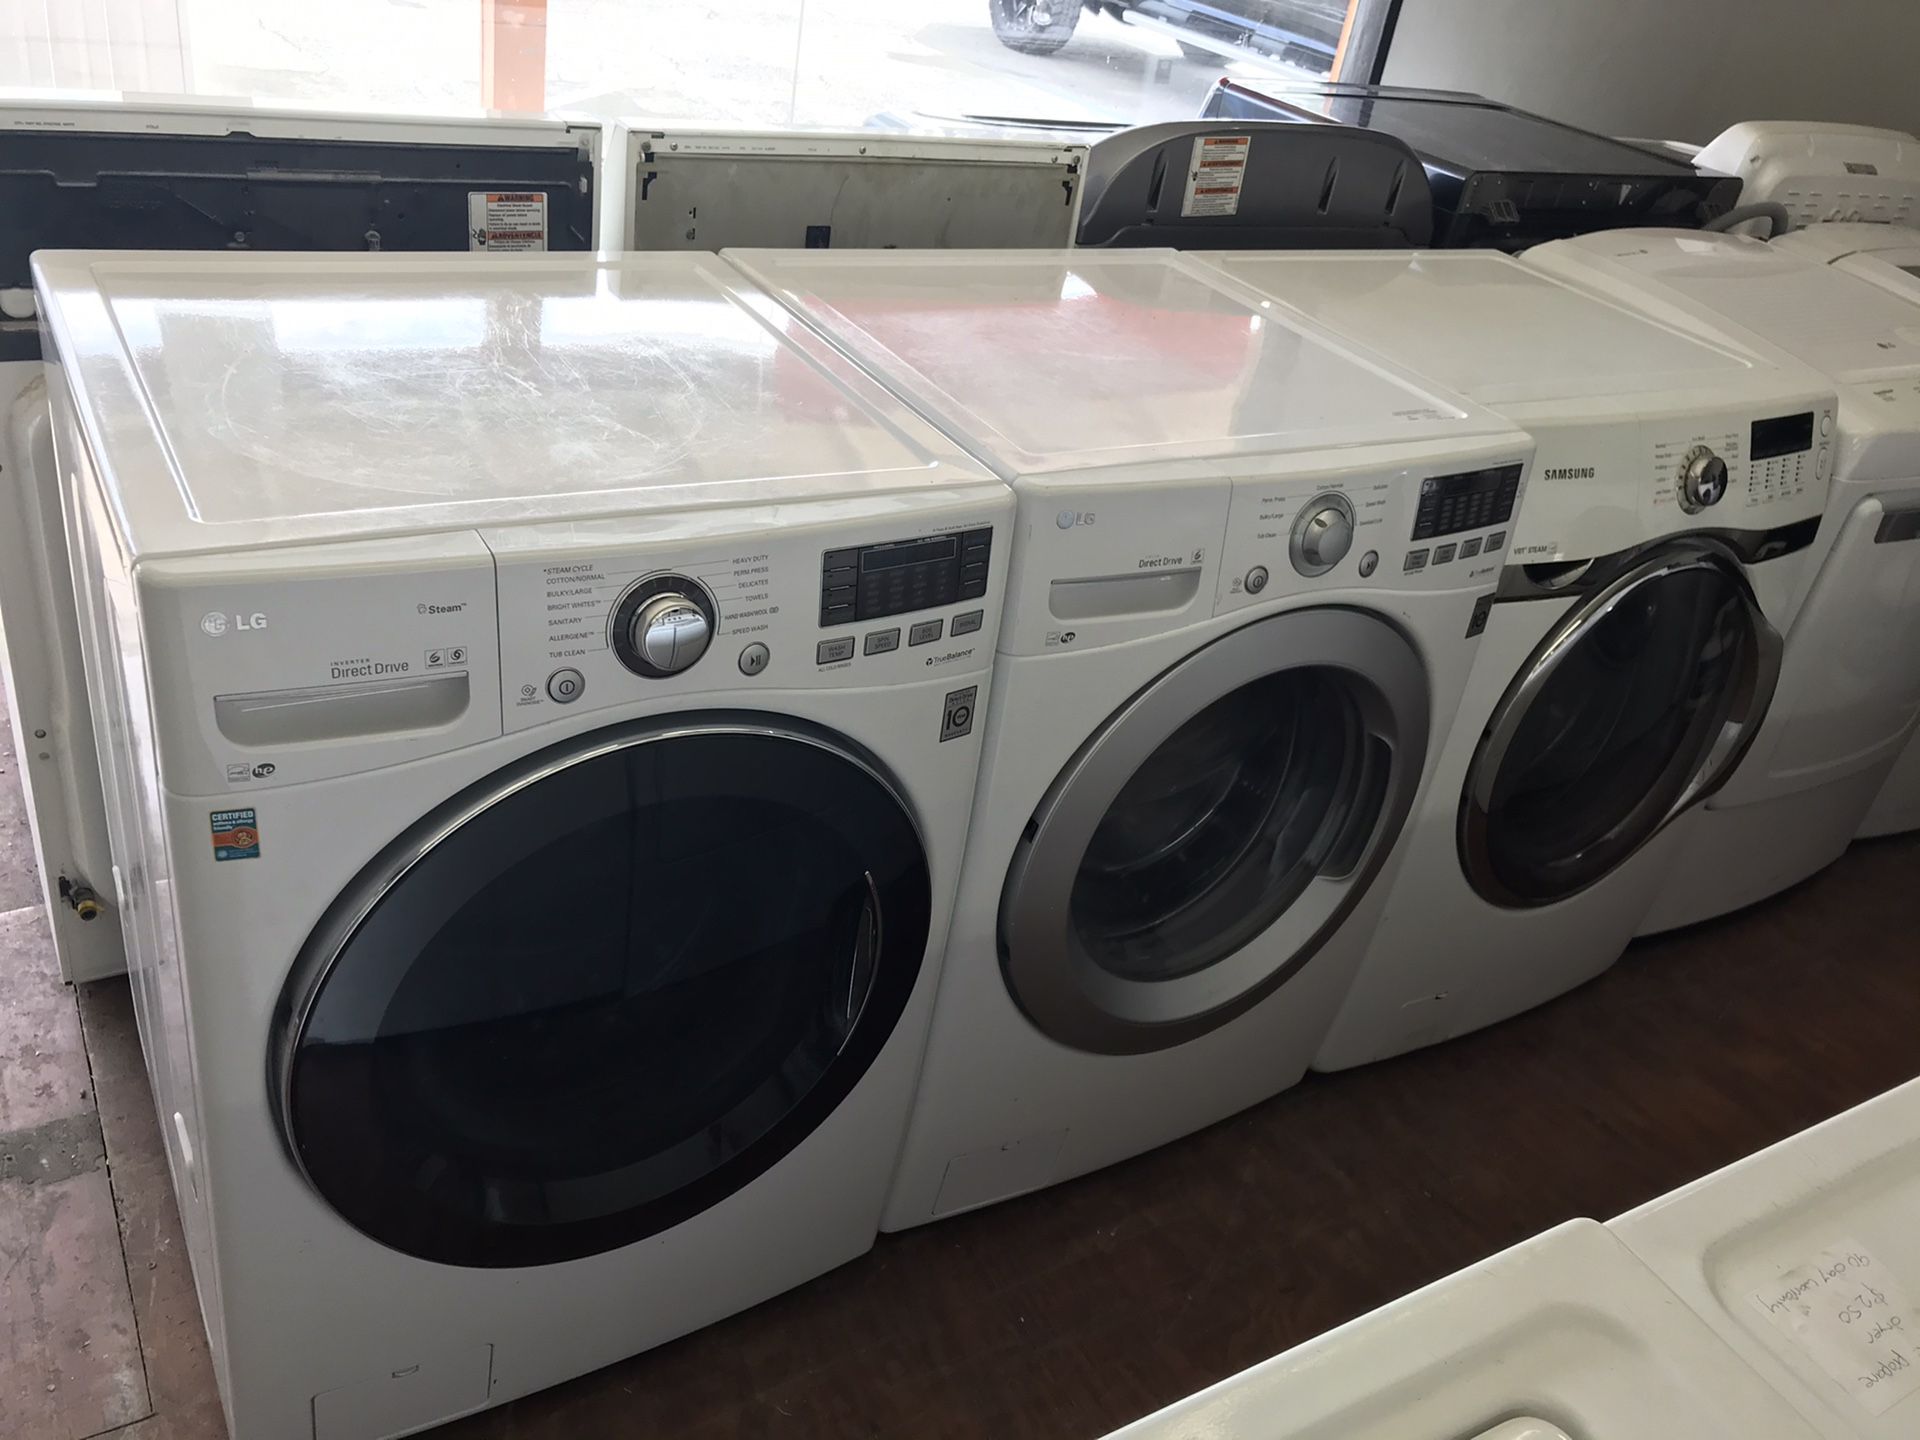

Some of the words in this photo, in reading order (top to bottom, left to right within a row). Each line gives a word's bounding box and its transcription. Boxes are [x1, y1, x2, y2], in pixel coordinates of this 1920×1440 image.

[1544, 467, 1595, 481] SAMSUNG
[1075, 512, 1096, 525] LG
[732, 556, 752, 564] HEAVY
[752, 554, 769, 562] DUTY
[1138, 556, 1162, 569] Direct
[1163, 556, 1183, 567] Drive
[572, 564, 593, 573] CYCLE
[546, 573, 605, 585] COTTON/NORMAL
[738, 578, 769, 589] DELICATES
[546, 587, 593, 598] BULKY/LARGE
[745, 593, 769, 602] TOWELS
[547, 602, 570, 611] BRIGHT
[236, 612, 268, 631] LG
[548, 617, 583, 626] SANITARY
[732, 626, 750, 635] SPEED
[751, 624, 769, 632] WASH
[549, 650, 563, 658] TUB
[564, 649, 586, 657] CLEAN
[330, 658, 370, 667] INVERTER
[331, 663, 373, 679] Direct
[375, 661, 409, 675] Drive
[212, 811, 254, 821] CERTIFIED
[1846, 1253, 1871, 1268] 90
[1838, 1282, 1889, 1324] $250
[1866, 1315, 1904, 1345] dryer
